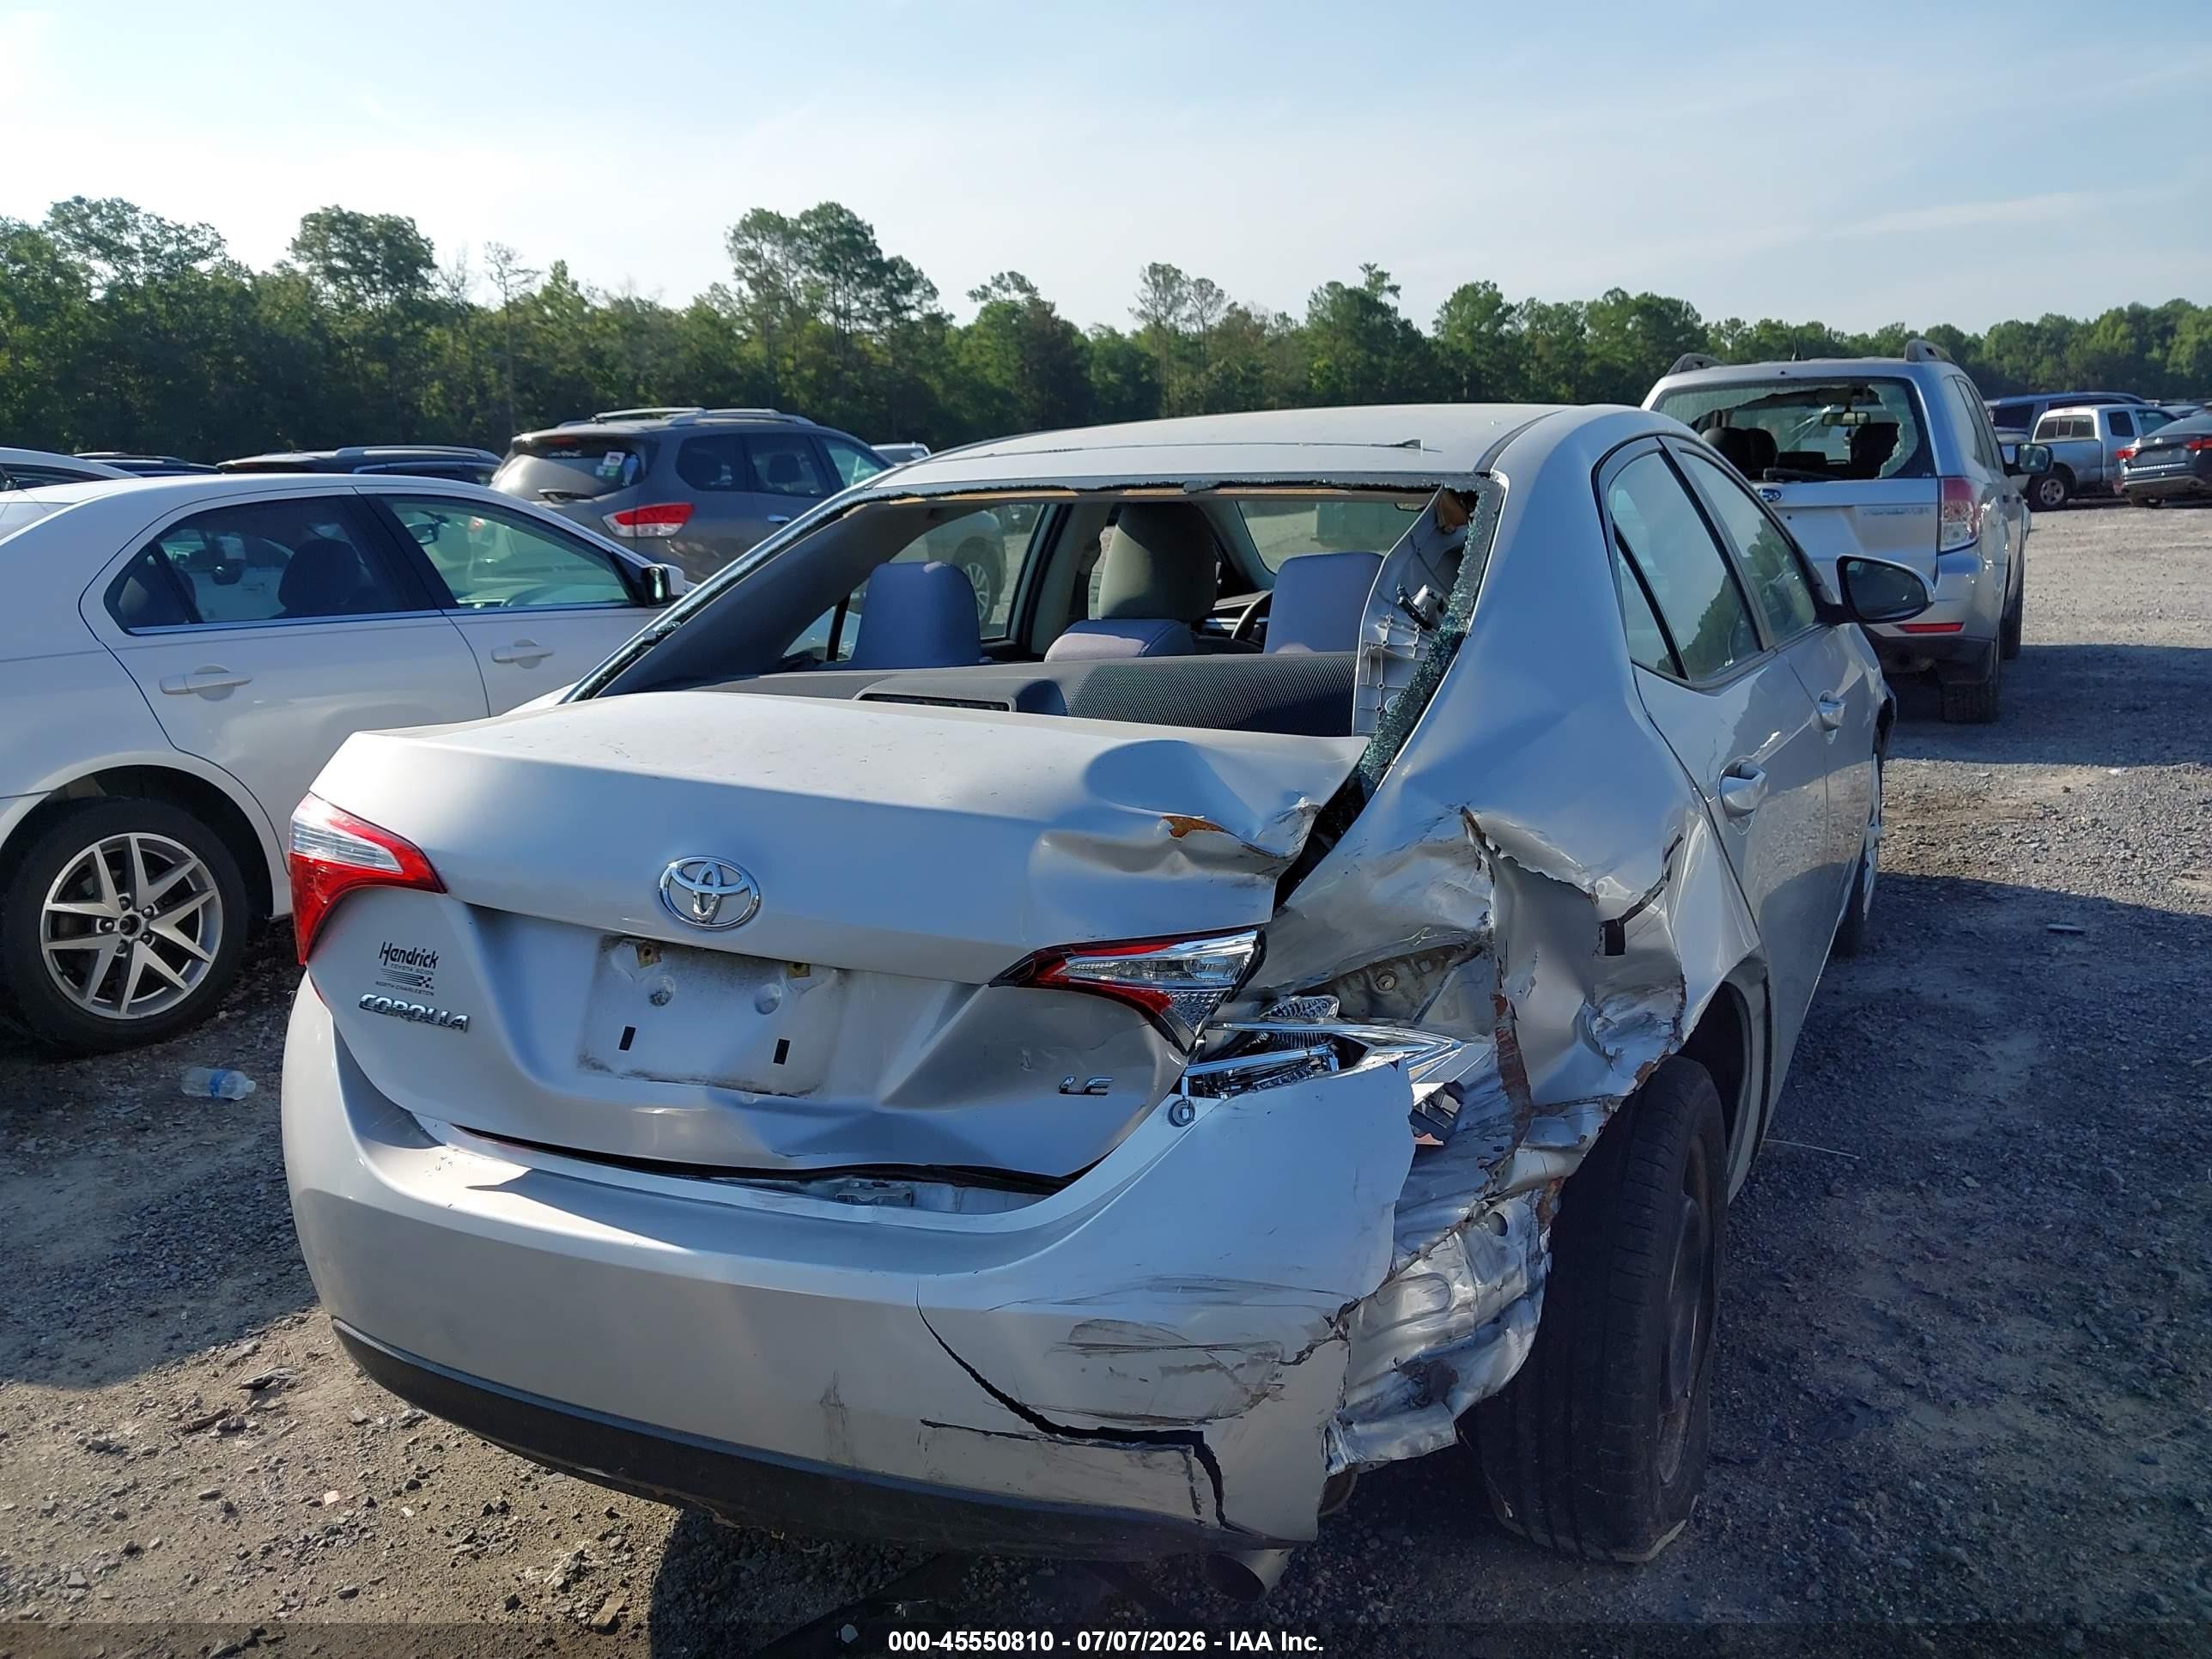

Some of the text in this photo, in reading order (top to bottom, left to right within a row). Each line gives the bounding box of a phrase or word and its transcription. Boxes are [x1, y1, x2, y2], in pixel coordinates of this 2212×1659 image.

[379, 941, 439, 969] Hendrick
[391, 963, 413, 971] TOYOTA
[395, 985, 434, 996] CHARLESTON
[359, 994, 470, 1032] COROLLA
[1058, 1076, 1114, 1097] LE
